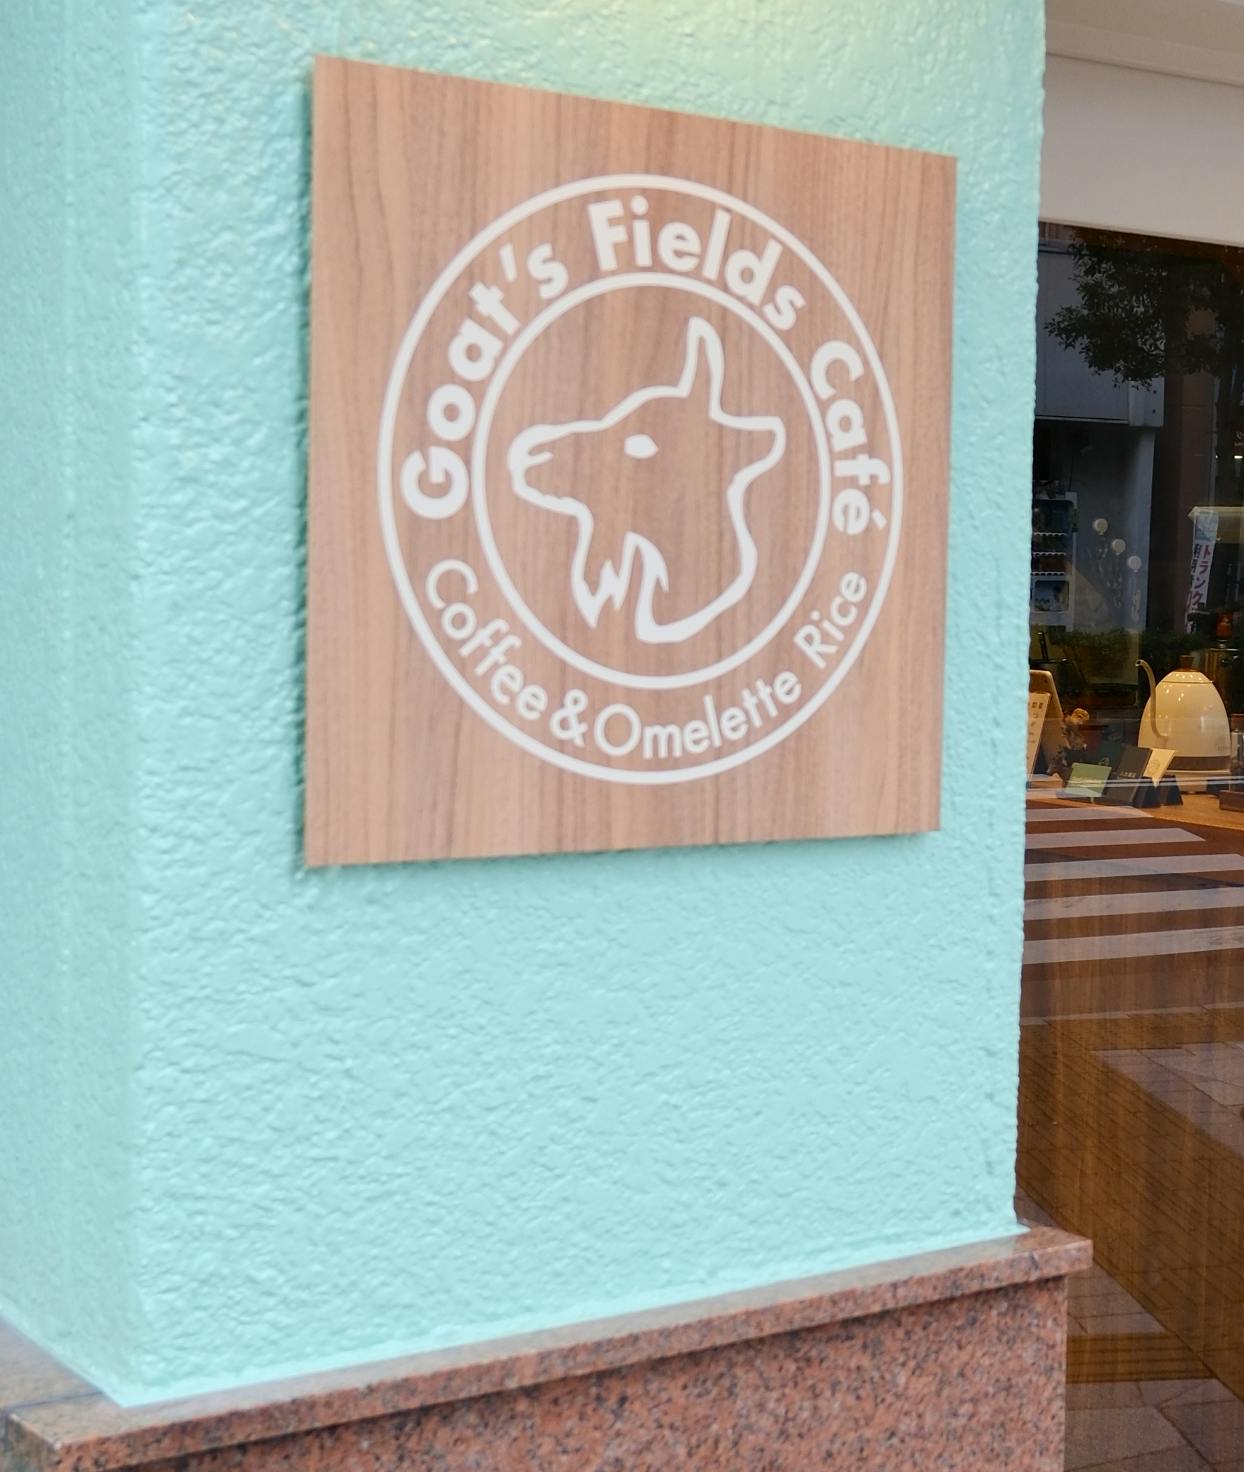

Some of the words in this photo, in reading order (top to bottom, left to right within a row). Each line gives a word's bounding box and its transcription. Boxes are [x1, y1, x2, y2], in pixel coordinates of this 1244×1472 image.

[401, 237, 569, 520] Goat's
[588, 196, 807, 330] Fields
[810, 340, 891, 536] Café
[793, 571, 868, 670] Rice
